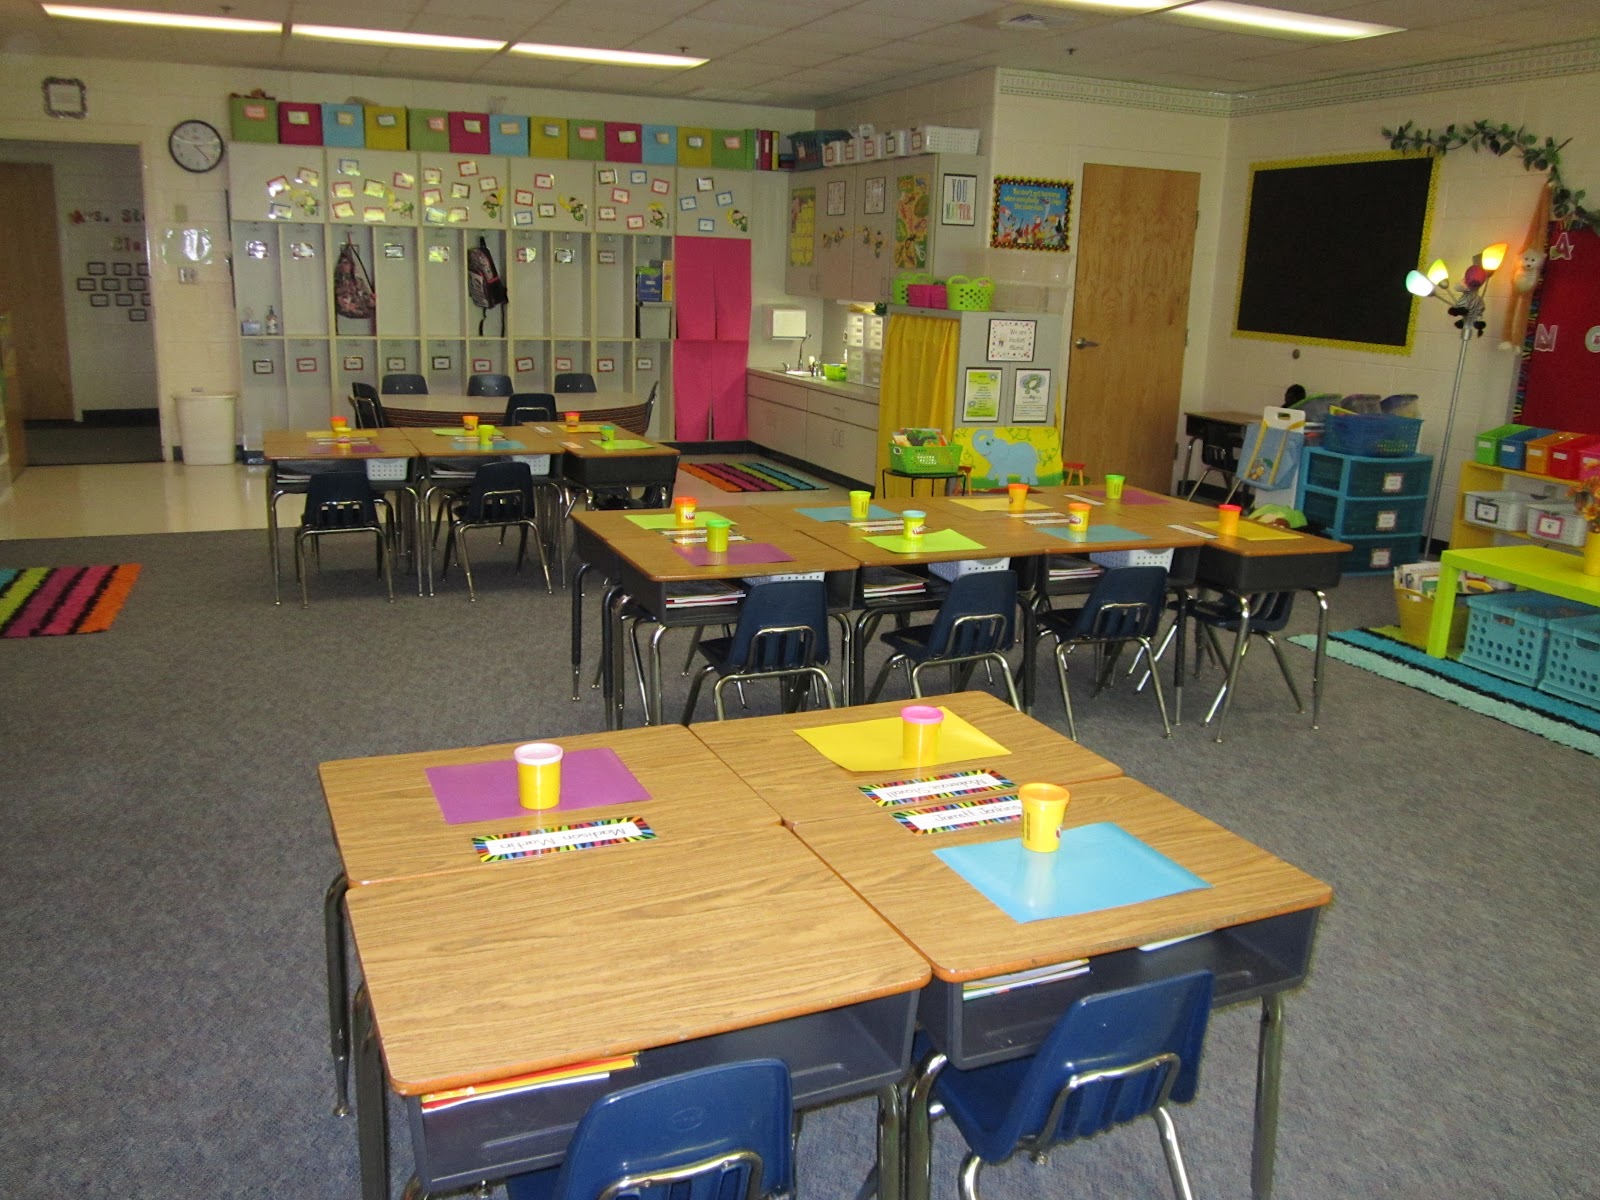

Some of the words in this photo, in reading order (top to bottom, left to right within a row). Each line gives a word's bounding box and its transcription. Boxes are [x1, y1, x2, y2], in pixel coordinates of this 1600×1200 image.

[952, 178, 968, 202] YOU
[946, 203, 973, 220] MATTER
[1534, 323, 1558, 351] N
[561, 827, 627, 841] Madison
[499, 837, 556, 851] Martin
